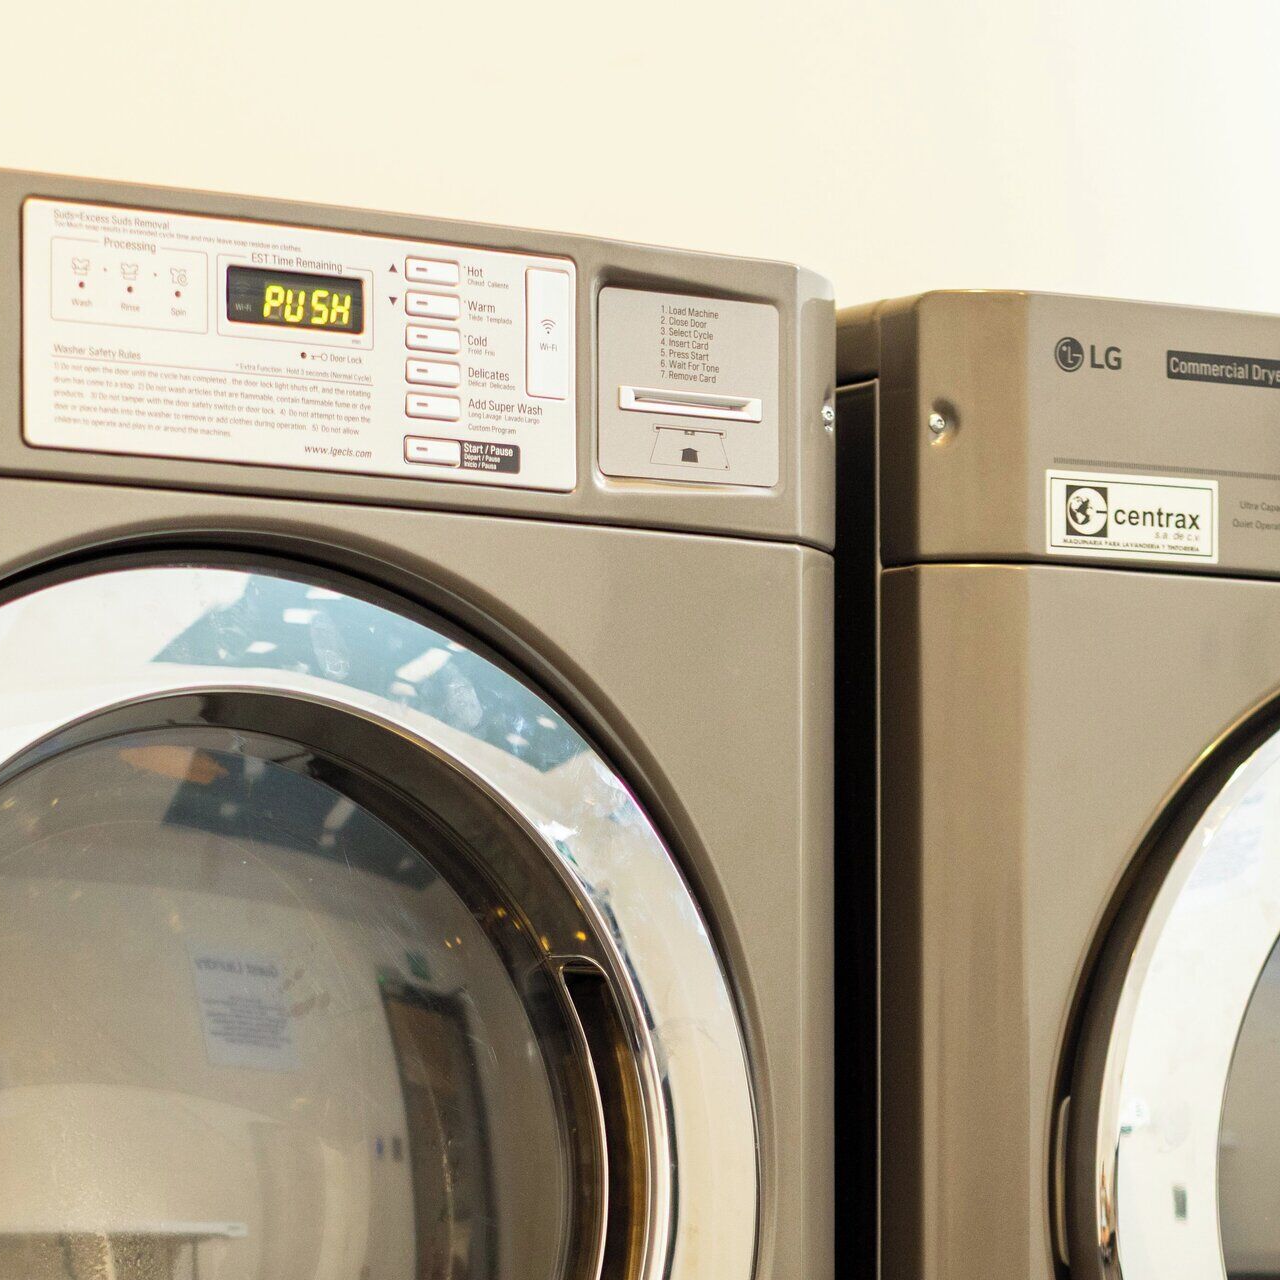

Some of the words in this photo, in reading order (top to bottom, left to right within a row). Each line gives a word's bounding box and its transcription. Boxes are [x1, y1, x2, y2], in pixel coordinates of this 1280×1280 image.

[110, 215, 132, 226] Suds
[134, 217, 170, 230] Removal
[104, 236, 156, 255] Processing
[272, 255, 294, 267] Time
[296, 257, 342, 275] Remaining
[468, 279, 484, 287] Chaud
[487, 281, 510, 289] Caliente
[71, 298, 92, 308] Wash
[120, 302, 140, 312] Rinse
[170, 307, 186, 316] Spin
[262, 285, 352, 325] PUSH
[669, 306, 686, 316] Load
[688, 308, 719, 319] Machine
[669, 317, 688, 326] Close
[690, 319, 707, 328] Door
[669, 328, 691, 338] Select
[693, 330, 714, 341] Cycle
[540, 342, 558, 352] Wi-Fi
[669, 339, 690, 348] Insert
[692, 341, 709, 350] Card
[54, 344, 86, 355] Washer
[88, 347, 116, 360] Safety
[118, 350, 142, 361] Rules
[330, 354, 346, 362] Door
[347, 355, 363, 364] Lock
[669, 350, 689, 360] Press
[690, 352, 709, 361] Start
[1090, 345, 1122, 370] LG
[240, 362, 256, 371] Extra
[256, 364, 282, 374] Function
[286, 367, 300, 375] Hold
[305, 370, 330, 378] seconds
[330, 371, 352, 380] (Normal
[353, 373, 372, 383] Cycle)
[669, 360, 686, 370] Wait
[688, 362, 700, 371] For
[702, 363, 720, 373] Tone
[1170, 357, 1248, 380] Commercial
[468, 367, 510, 382] Delicates
[669, 371, 698, 382] Remove
[699, 374, 716, 383] Card
[178, 373, 190, 382] has
[231, 378, 242, 386] the
[244, 379, 258, 388] door
[260, 381, 272, 389] lock
[274, 382, 288, 392] light
[290, 384, 308, 392] shuts
[322, 387, 334, 395] and
[334, 387, 345, 396] the
[346, 389, 370, 400] rotating
[489, 382, 516, 391] Delicados
[188, 388, 212, 396] articles
[213, 389, 226, 398] that
[276, 396, 300, 404] contain
[300, 397, 334, 407] flammable
[334, 400, 350, 409] fume
[359, 402, 371, 412] dye
[468, 398, 488, 410] Add
[488, 400, 516, 414] Super
[517, 403, 543, 416] Wash
[146, 397, 162, 405] with
[163, 398, 174, 406] the
[175, 399, 190, 408] door
[192, 401, 212, 411] safety
[214, 403, 236, 412] switch
[245, 405, 260, 414] door
[288, 409, 298, 417] Do
[298, 410, 309, 418] not
[310, 411, 335, 422] attempt
[336, 413, 343, 421] to
[344, 416, 360, 424] open
[360, 415, 371, 423] the
[98, 406, 118, 415] hands
[120, 408, 134, 416] into
[134, 409, 146, 417] the
[146, 411, 170, 419] washer
[215, 416, 228, 424] add
[229, 417, 252, 427] clothes
[254, 419, 275, 430] during
[320, 425, 330, 433] Do
[342, 428, 360, 436] allow
[468, 412, 482, 420] Long
[482, 413, 502, 422] Lavage
[504, 415, 524, 423] Lavado
[524, 416, 540, 425] Largo
[90, 420, 116, 428] operate
[118, 421, 130, 429] and
[131, 422, 146, 432] play
[188, 426, 198, 434] the
[468, 424, 491, 432] Custom
[492, 426, 516, 435] Program
[464, 442, 484, 455] Start
[485, 444, 489, 455] /
[490, 446, 513, 457] Pause
[464, 460, 477, 469] Inicio
[1114, 505, 1200, 530] centrax
[1232, 518, 1253, 528] Quiet
